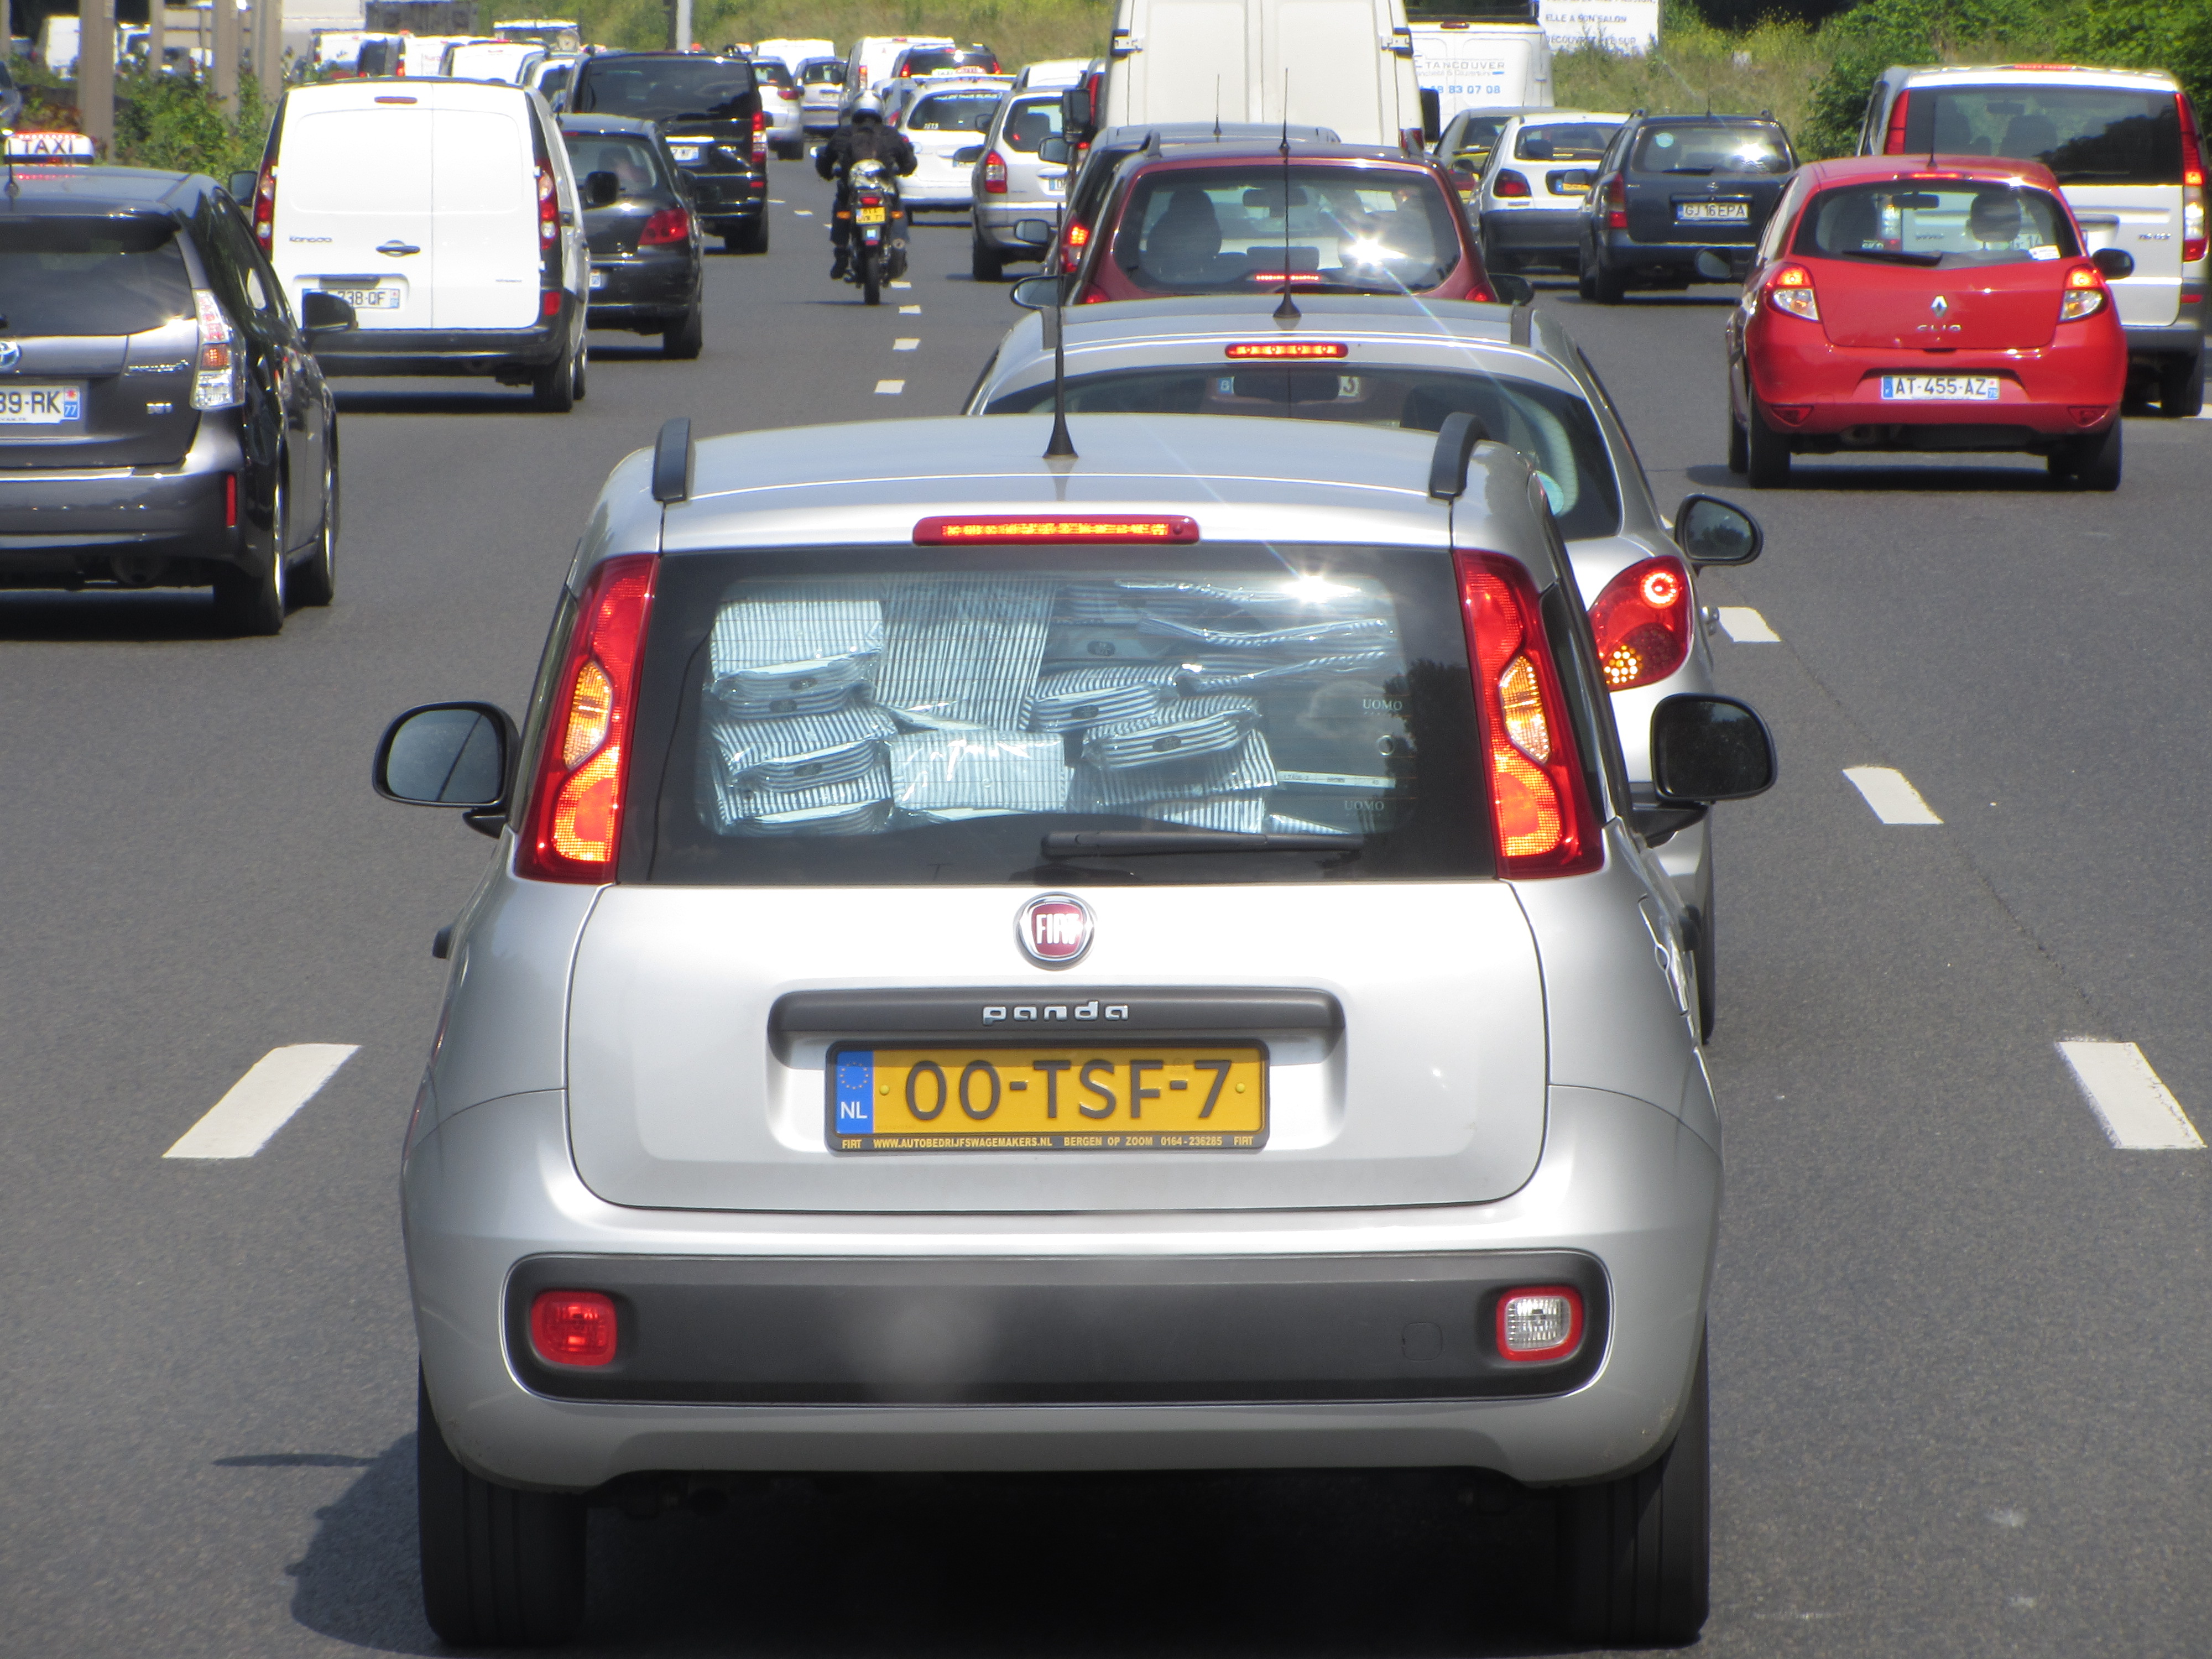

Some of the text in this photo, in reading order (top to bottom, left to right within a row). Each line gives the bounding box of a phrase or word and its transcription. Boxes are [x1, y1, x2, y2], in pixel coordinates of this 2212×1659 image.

[1449, 85, 1463, 93] 83
[1467, 85, 1481, 93] 07
[1486, 85, 1500, 93] 08
[22, 138, 72, 154] TAXI
[1896, 378, 1986, 395] AT-455-AZ
[65, 405, 77, 415] 77
[1363, 699, 1402, 711] UOMO
[1344, 801, 1384, 811] UOMO
[1036, 913, 1080, 945] FIAT
[982, 1001, 1129, 1026] panda
[906, 1060, 1232, 1120] 00-TSF-7
[840, 1101, 868, 1119] NL
[842, 1139, 862, 1149] FIAT
[873, 1137, 1053, 1148] WWW.AUTOBEDRIJFSWAGEMAKERS.NL
[1063, 1136, 1103, 1146] BERGEN
[1107, 1136, 1120, 1146] OP
[1125, 1136, 1154, 1146] ZOOM
[1233, 1136, 1254, 1146] FIAT
